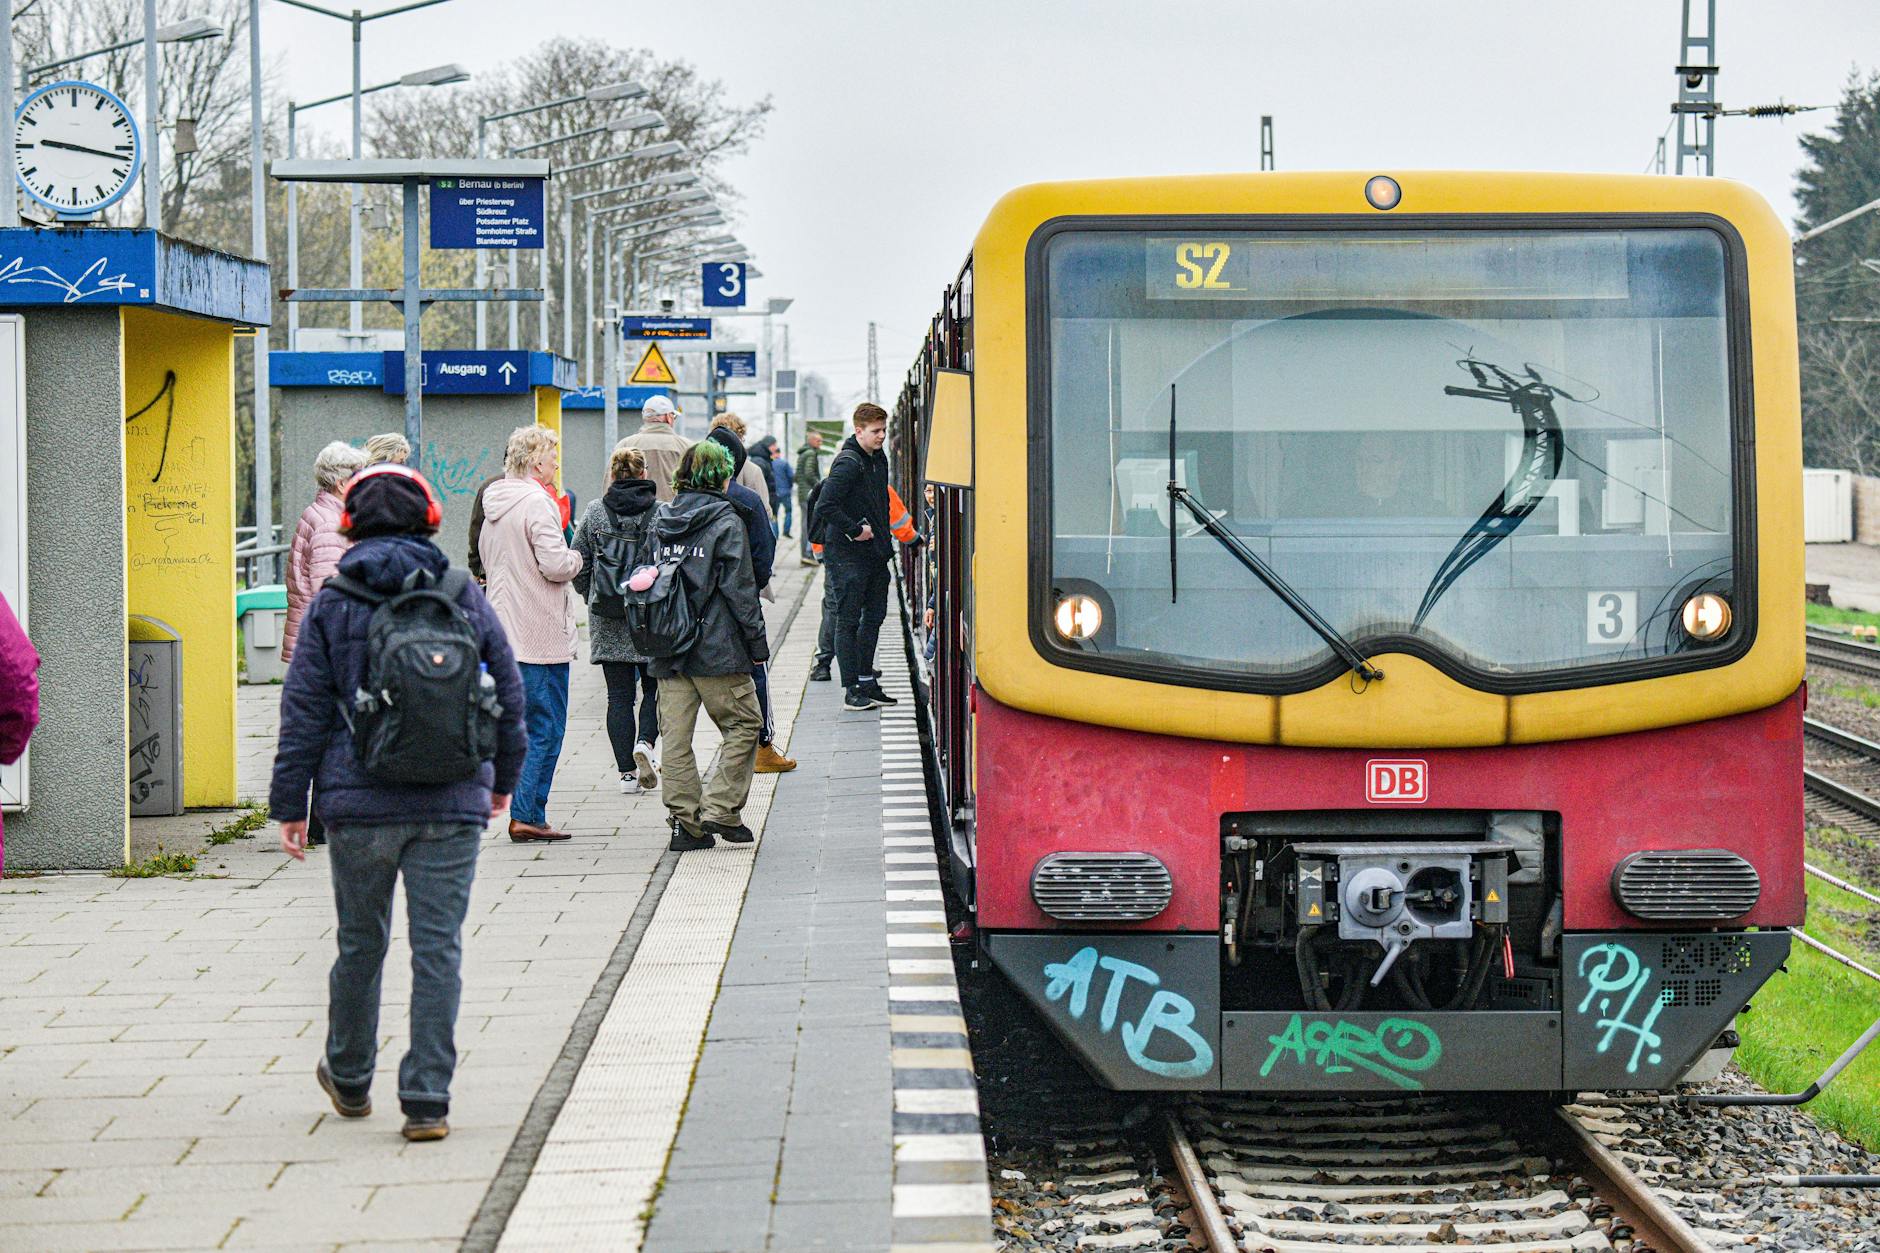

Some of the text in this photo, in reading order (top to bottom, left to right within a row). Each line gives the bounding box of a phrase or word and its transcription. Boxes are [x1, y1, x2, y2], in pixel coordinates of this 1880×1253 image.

[458, 179, 492, 189] Bernau
[493, 181, 501, 190] (b
[502, 181, 524, 189] Berlin)
[458, 198, 515, 207] über Priesterweg
[476, 208, 507, 216] Südkreuz
[476, 218, 529, 226] Potsdamer Platz
[476, 228, 537, 236] Bornholmer Straße
[476, 238, 517, 246] Blankenburg
[1176, 242, 1230, 289] S2
[718, 263, 741, 297] 3
[439, 363, 487, 376] Ausgang
[1597, 593, 1623, 639] 3
[1375, 767, 1420, 795] DB
